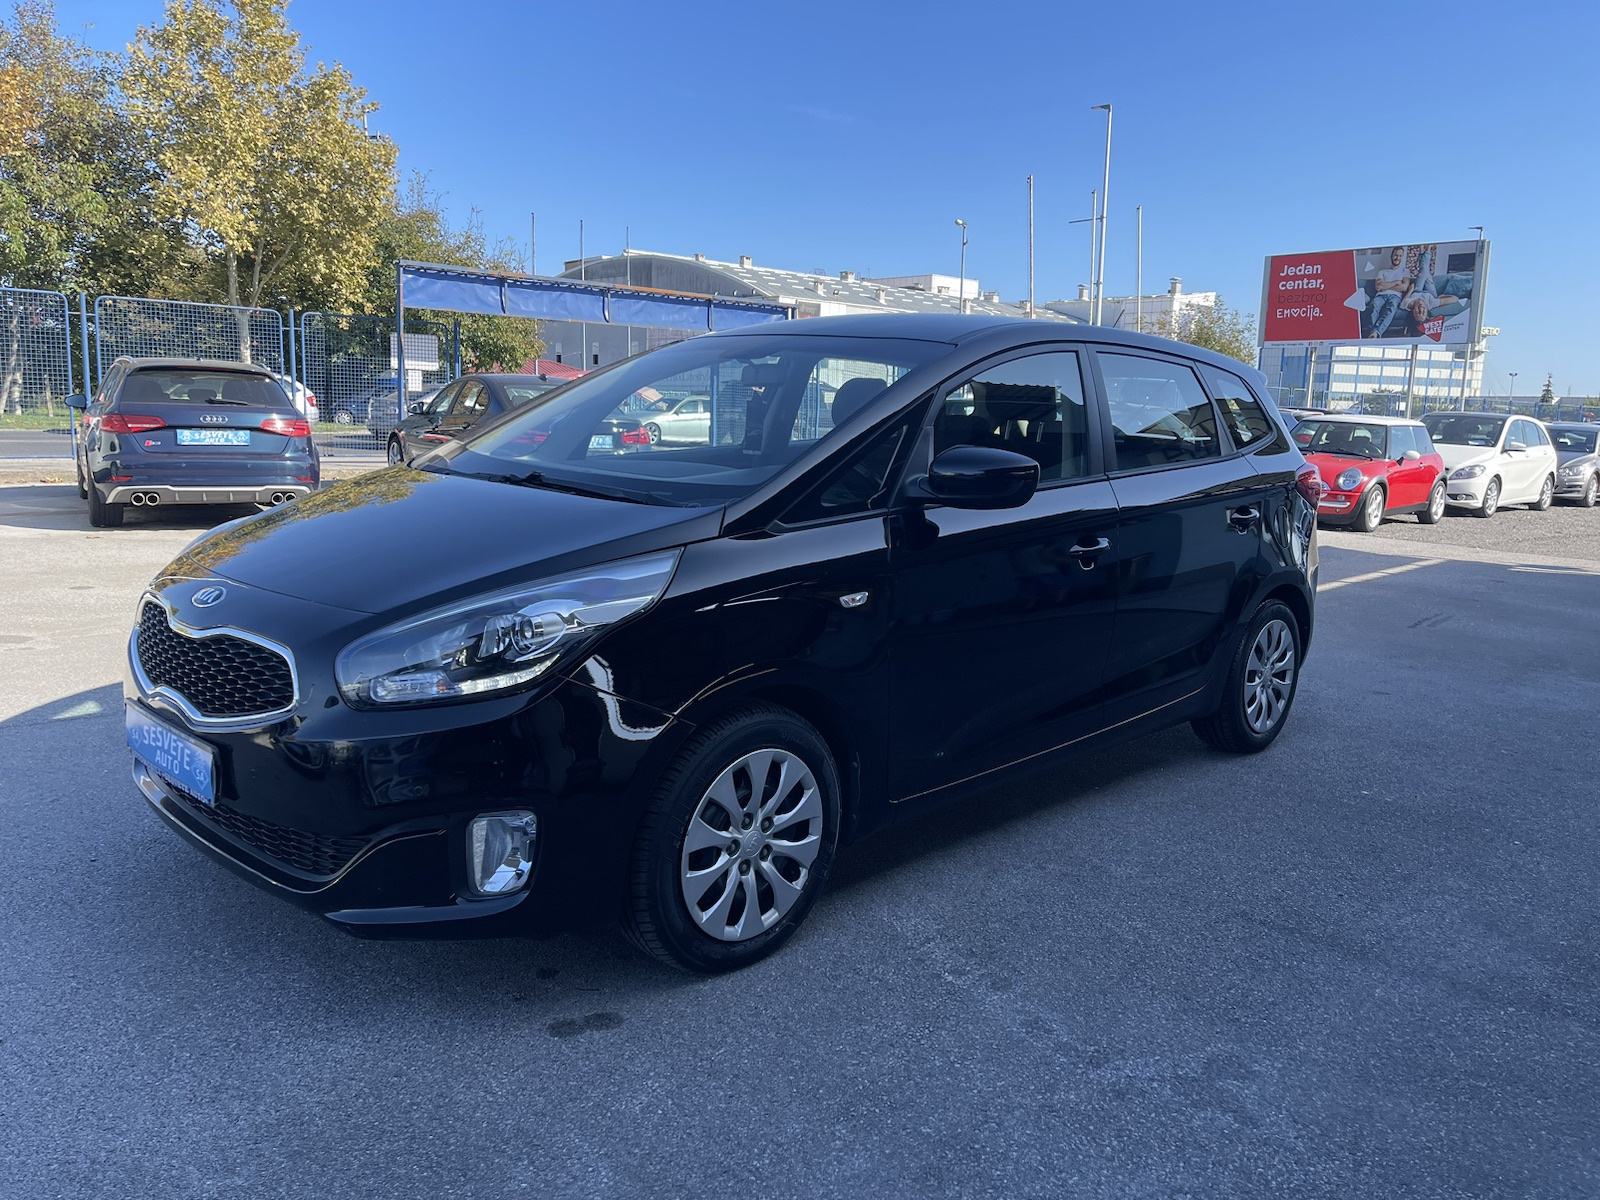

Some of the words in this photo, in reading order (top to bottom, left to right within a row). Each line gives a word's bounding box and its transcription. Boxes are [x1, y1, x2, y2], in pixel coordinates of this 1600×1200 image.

[1280, 264, 1321, 276] Jedan
[1279, 277, 1325, 290] centar,
[1423, 319, 1443, 329] WEST
[1424, 326, 1442, 335] GATE
[143, 726, 191, 770] SESVETE
[155, 749, 180, 774] AUTO
